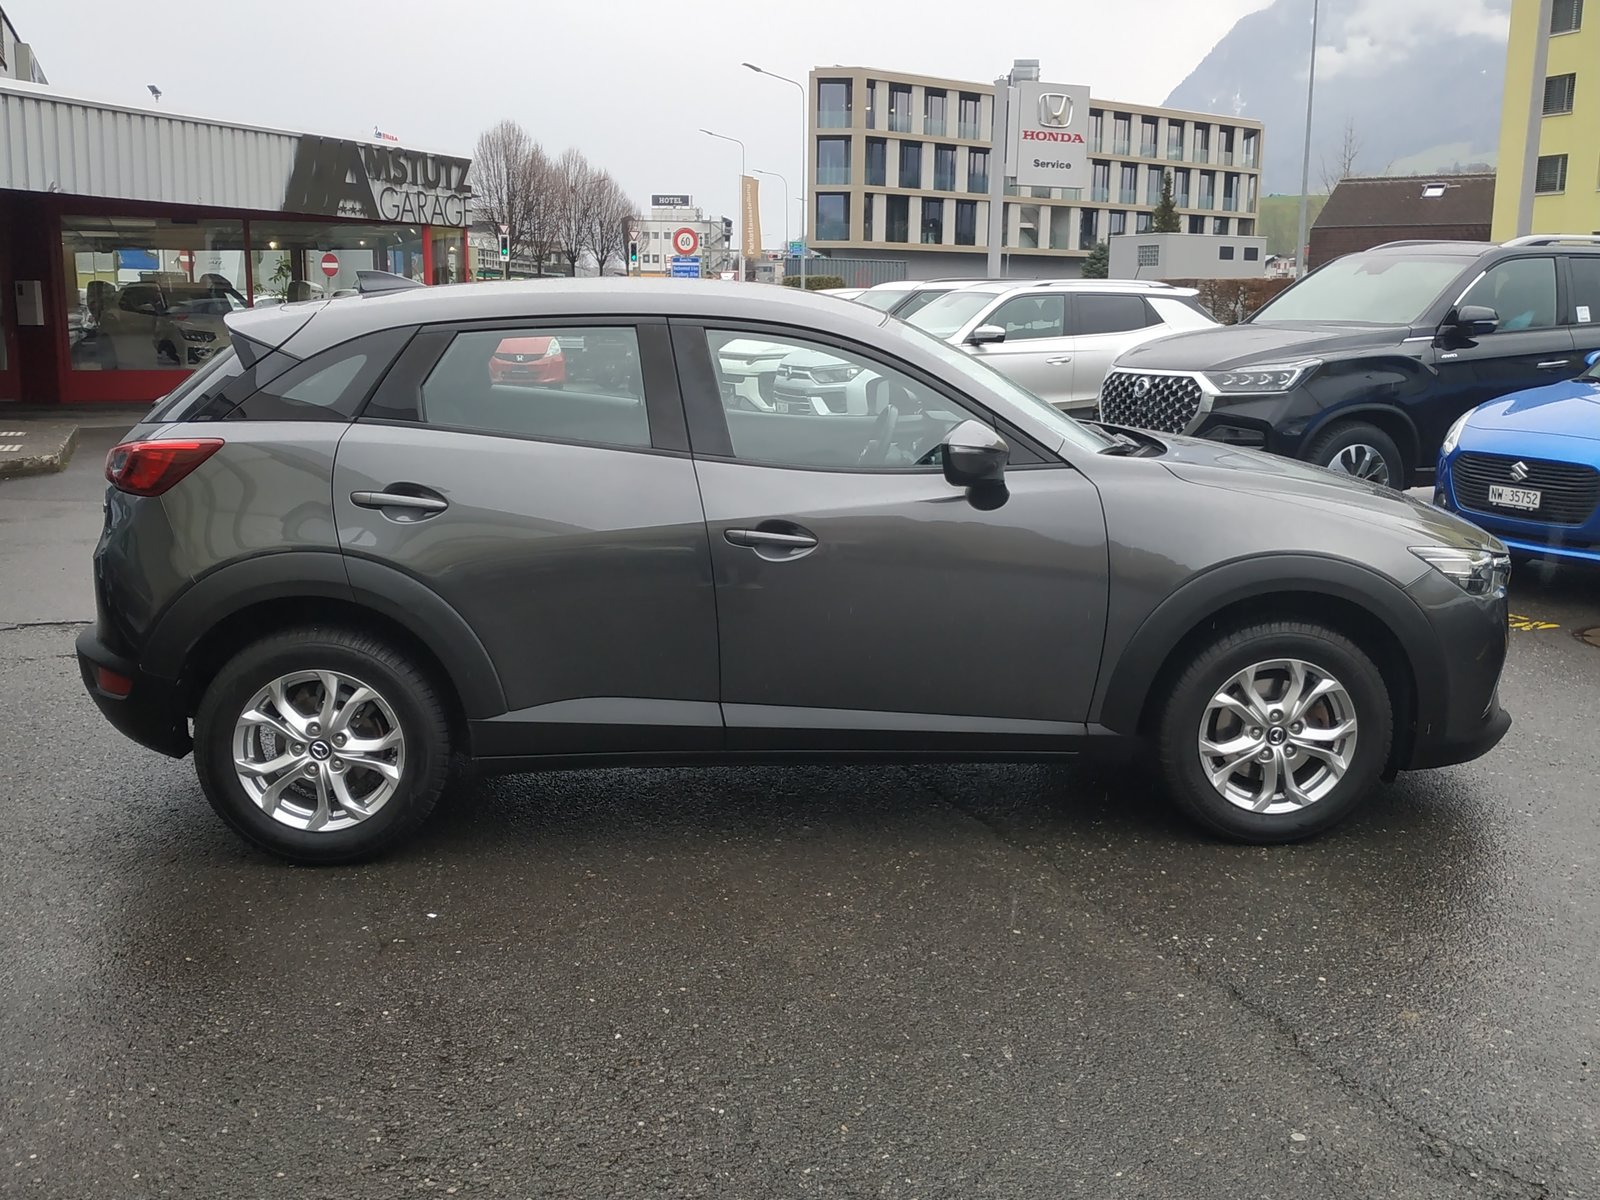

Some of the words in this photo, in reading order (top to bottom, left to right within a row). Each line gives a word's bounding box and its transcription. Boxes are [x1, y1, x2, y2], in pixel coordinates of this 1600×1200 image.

[1022, 130, 1085, 144] HONDA
[1033, 158, 1072, 170] Service
[310, 134, 472, 219] AMSTUTZ
[380, 187, 472, 227] GARAGE
[680, 236, 691, 247] 60
